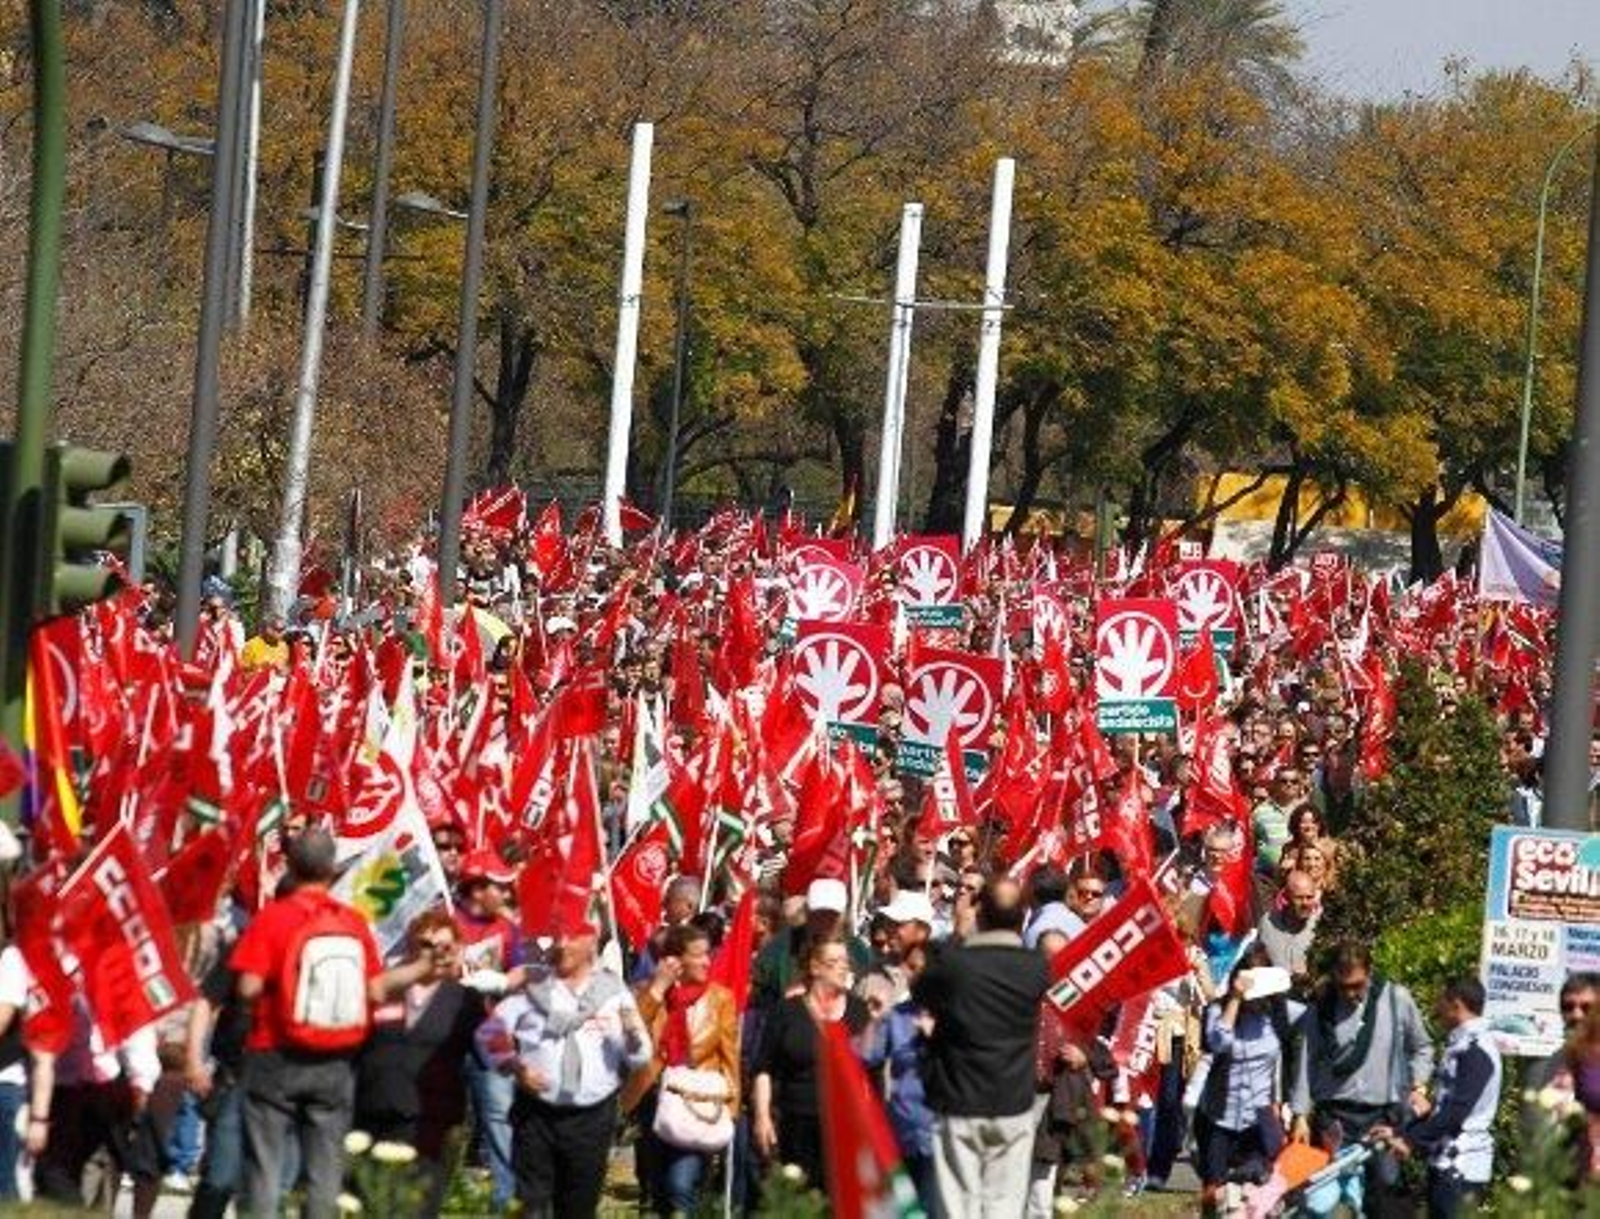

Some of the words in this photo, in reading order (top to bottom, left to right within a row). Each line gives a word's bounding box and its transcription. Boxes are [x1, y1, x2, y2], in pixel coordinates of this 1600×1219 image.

[1517, 839, 1577, 866] eco
[1491, 942, 1548, 960] MARZO
[1489, 963, 1540, 979] PALACIO
